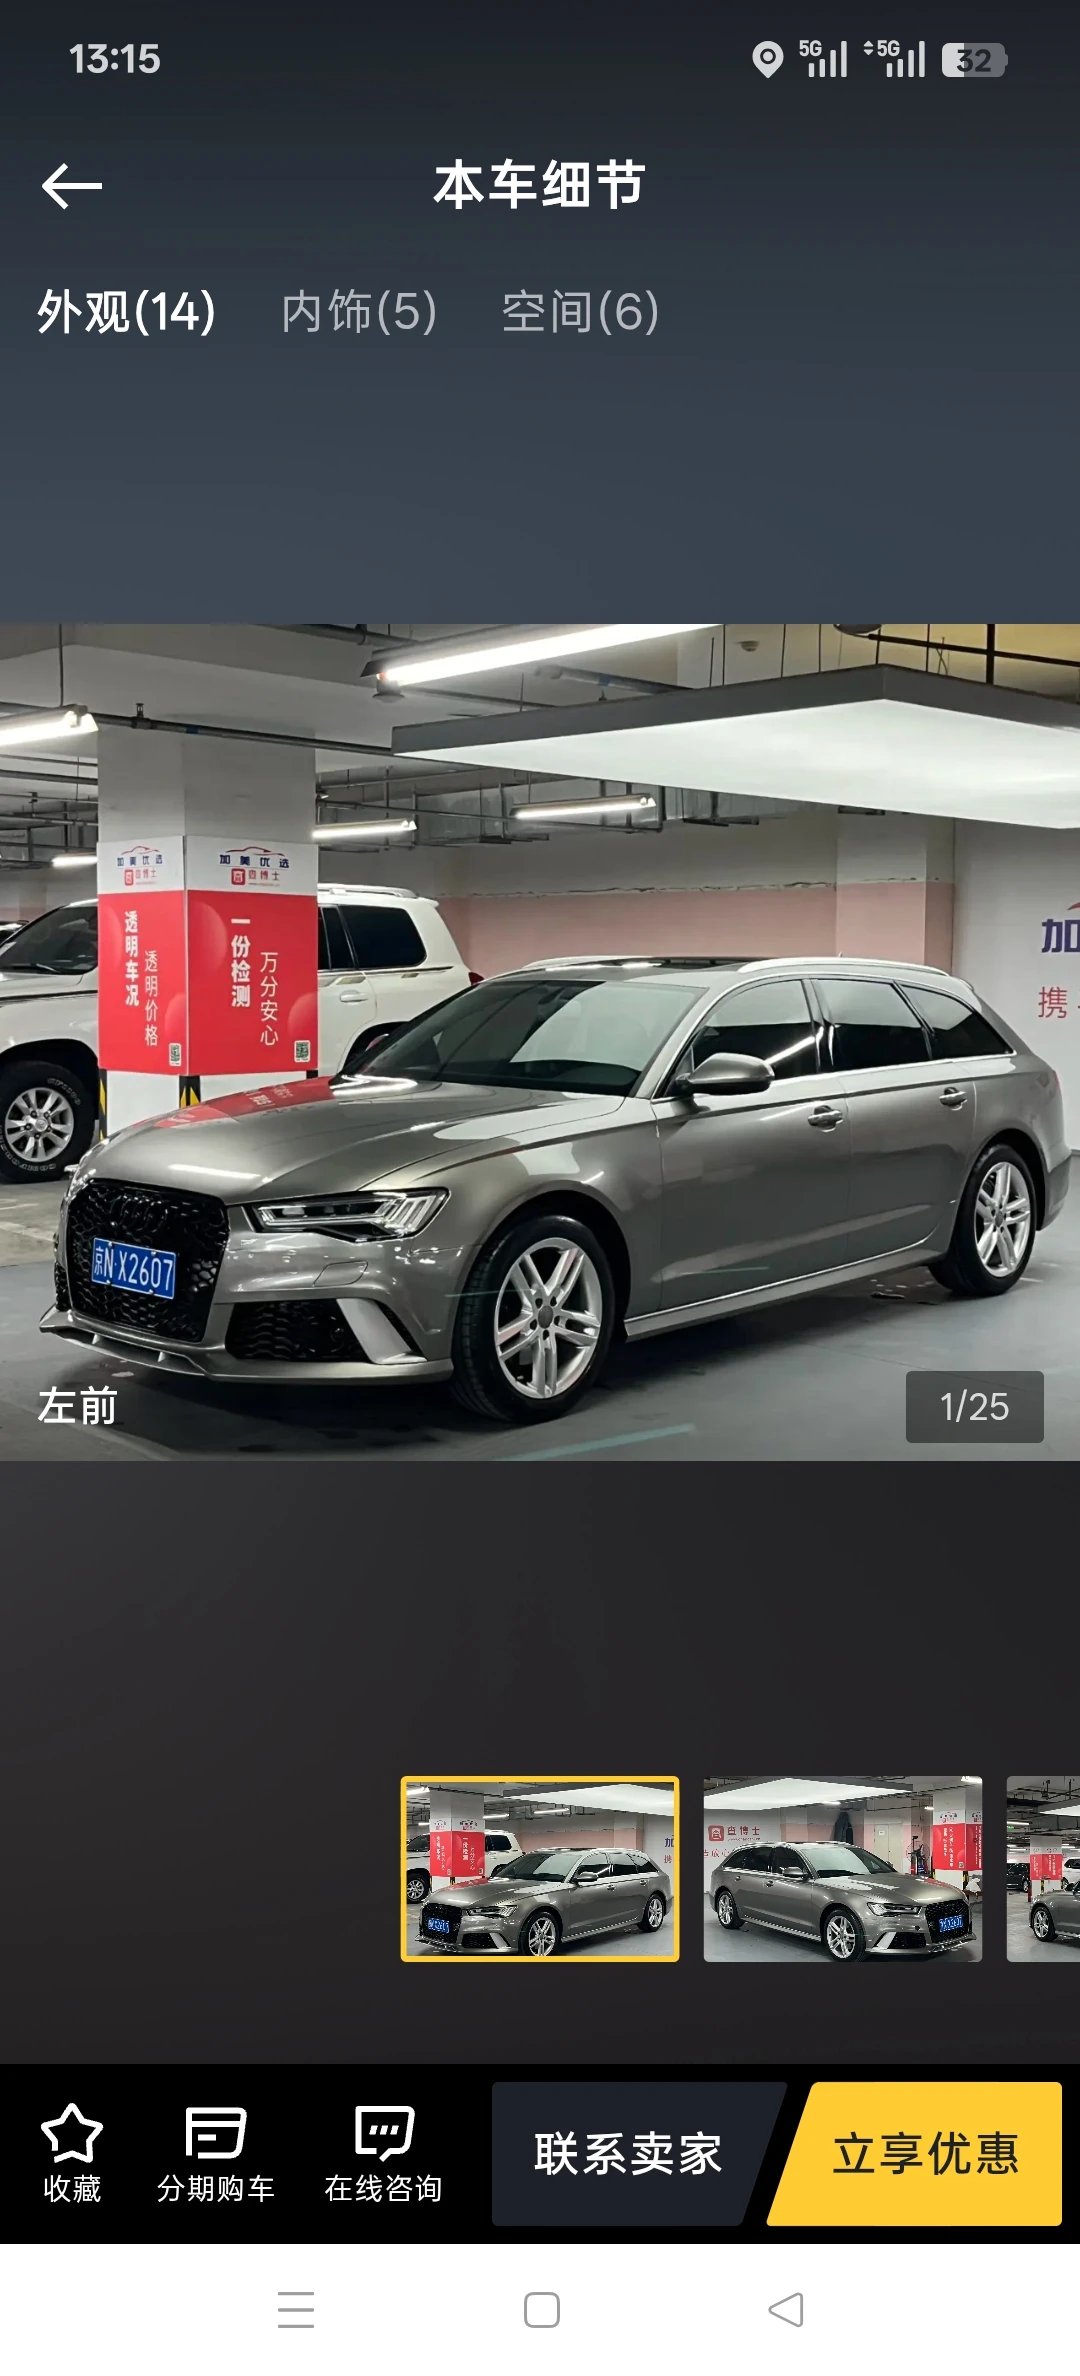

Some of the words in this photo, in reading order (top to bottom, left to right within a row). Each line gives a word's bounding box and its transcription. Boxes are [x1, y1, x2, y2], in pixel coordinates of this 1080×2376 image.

[70, 44, 160, 73] 13:15
[799, 40, 822, 56] 5G
[877, 40, 900, 56] 5G
[957, 49, 992, 72] 32
[433, 158, 646, 209] 本车细节
[37, 289, 215, 336] 外观(14)
[282, 289, 436, 335] 内饰(5)
[502, 289, 658, 335] 空间(6)
[219, 854, 290, 868] 加美优选
[125, 910, 140, 1007] 透明车况
[231, 918, 250, 1007] 一份检测
[144, 950, 159, 1047] 透明价格
[260, 952, 279, 1046] 万分安心
[1038, 986, 1080, 1018] 携
[533, 2130, 723, 2176] 联系卖家
[832, 2130, 1019, 2176] 立享优惠
[43, 2173, 102, 2203] 收藏
[156, 2173, 275, 2203] 分期购车
[324, 2173, 442, 2203] 在线咨询
